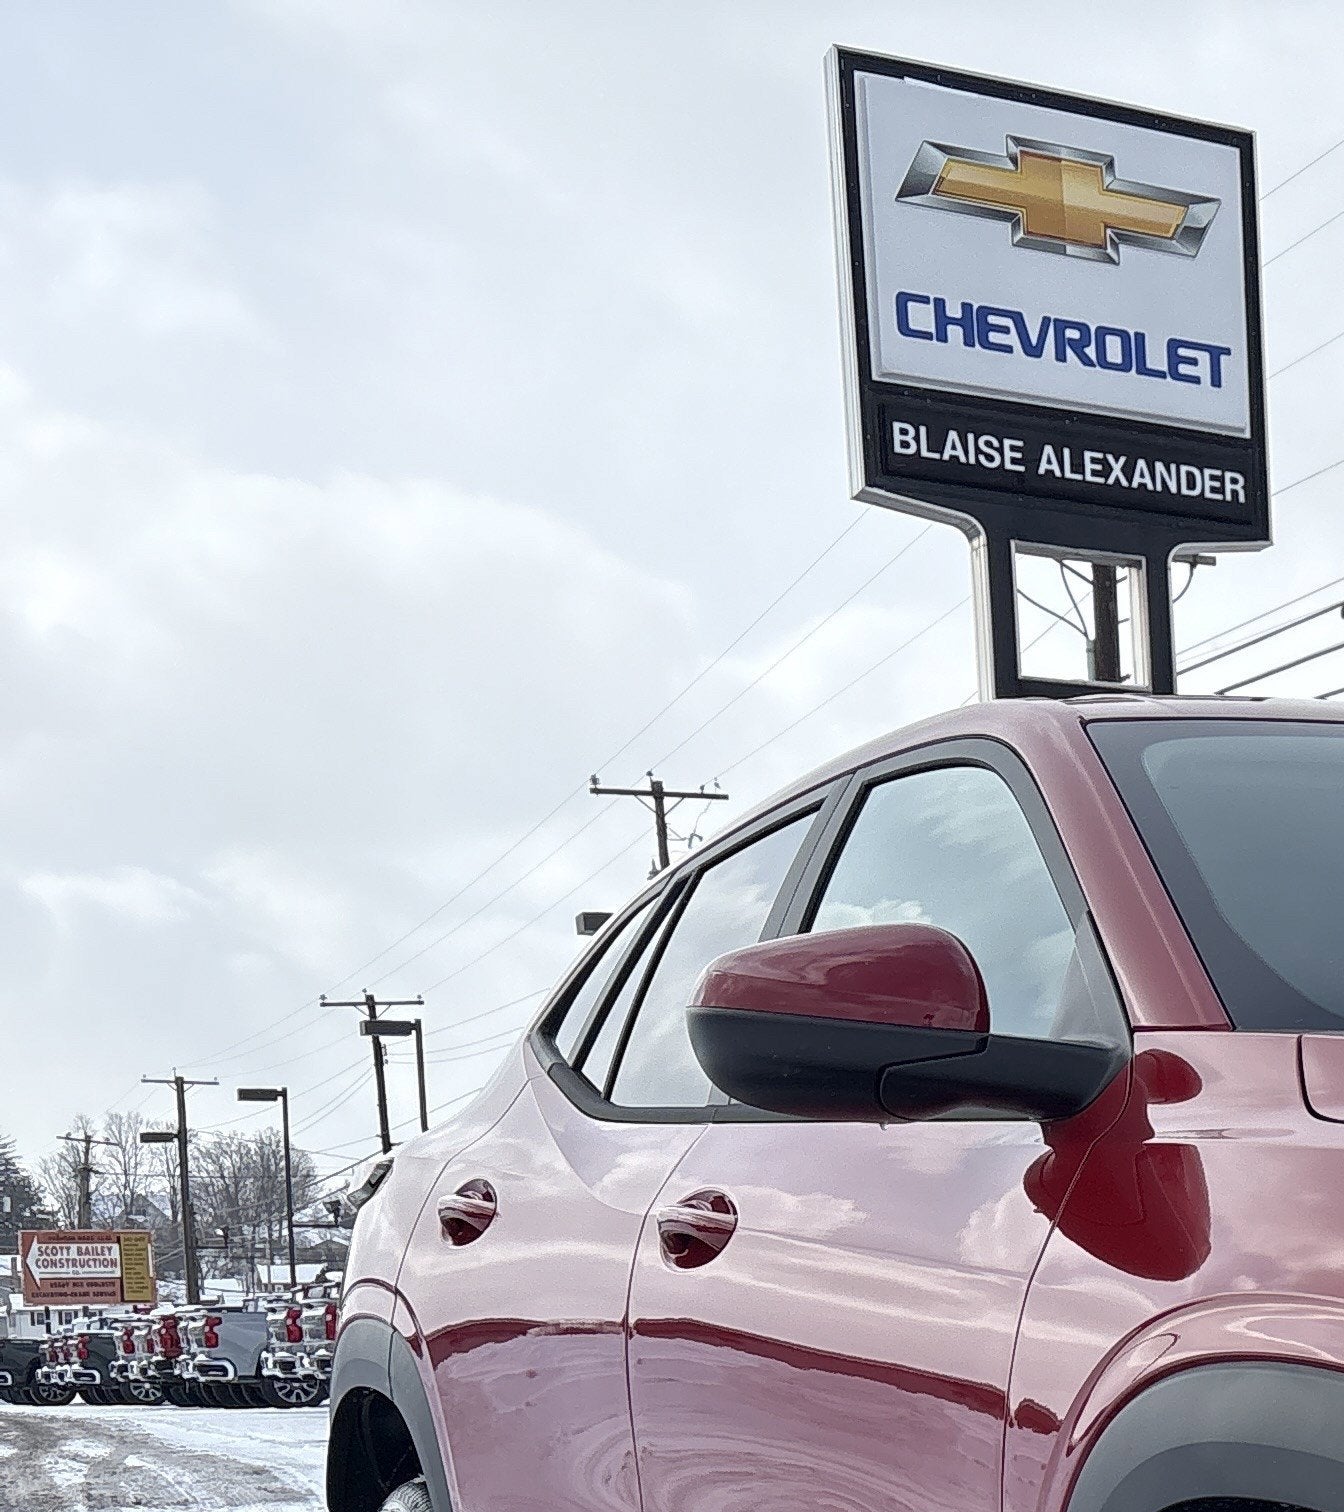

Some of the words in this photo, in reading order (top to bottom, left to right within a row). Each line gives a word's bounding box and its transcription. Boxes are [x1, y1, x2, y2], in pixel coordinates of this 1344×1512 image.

[895, 290, 1232, 389] CHEVROLET
[892, 421, 1026, 473] BLAISE
[1037, 444, 1246, 504] ALEXANDER
[35, 1257, 118, 1269] CONSTRUCTION
[37, 1245, 71, 1257] SCOTT
[76, 1245, 114, 1257] BAILEY
